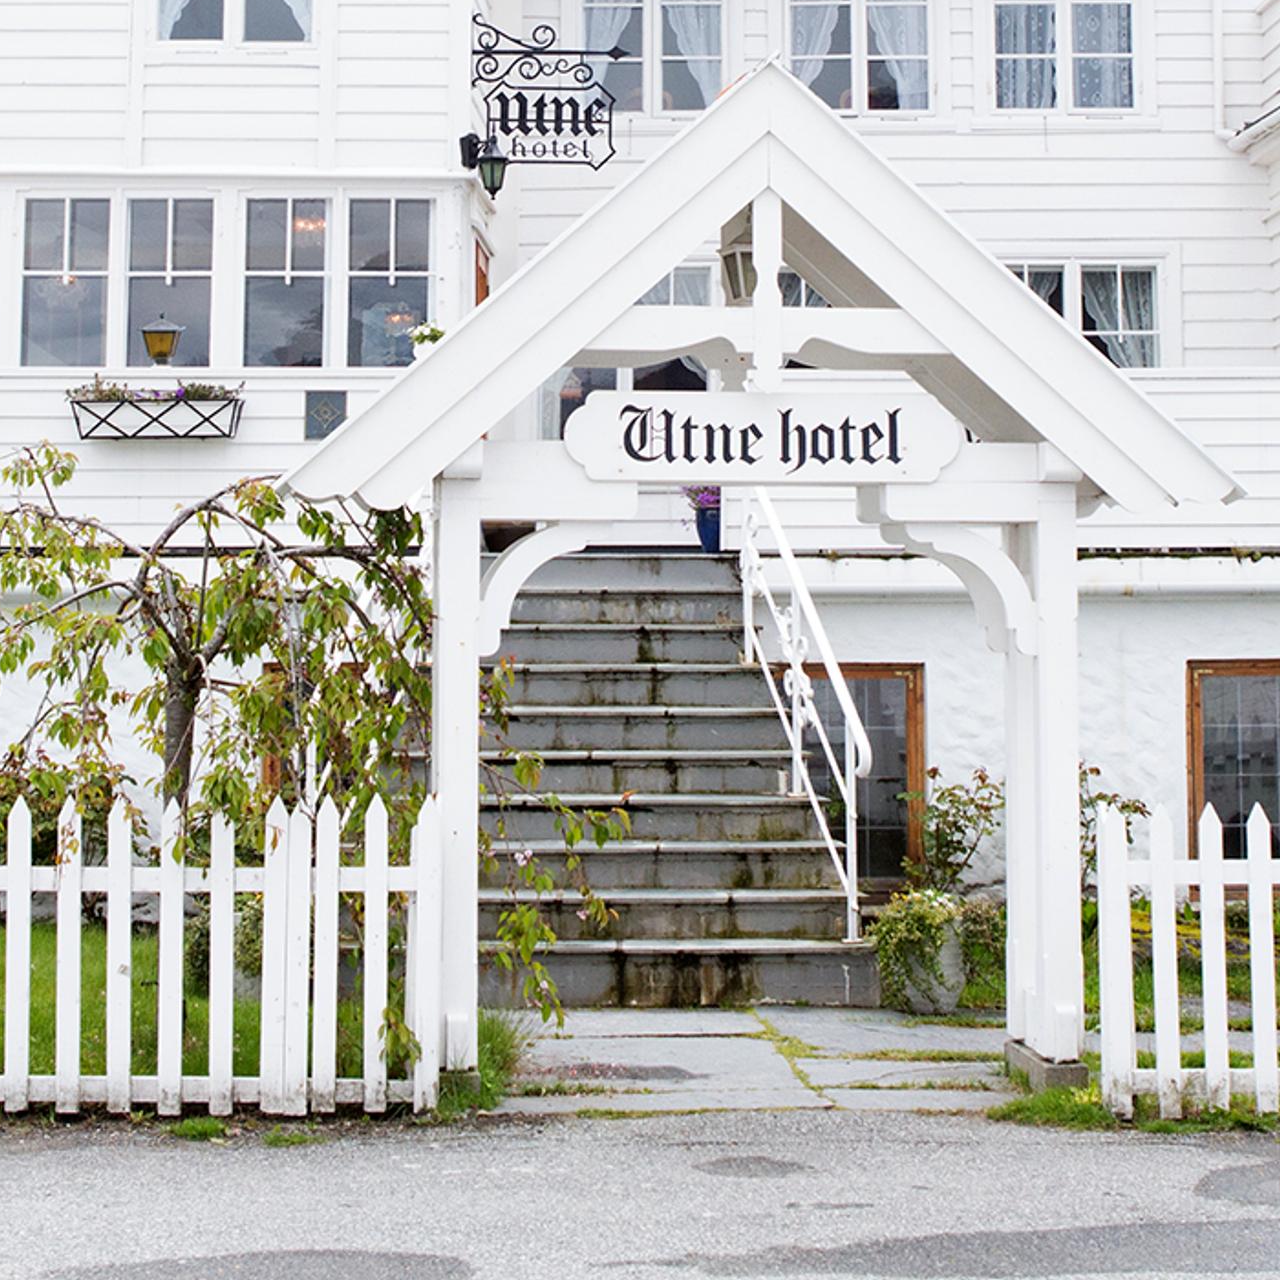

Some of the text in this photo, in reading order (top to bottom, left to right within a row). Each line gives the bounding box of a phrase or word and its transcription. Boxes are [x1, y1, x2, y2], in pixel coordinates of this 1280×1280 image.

[511, 135, 590, 158] hotel
[620, 404, 902, 475] Utne hotel
